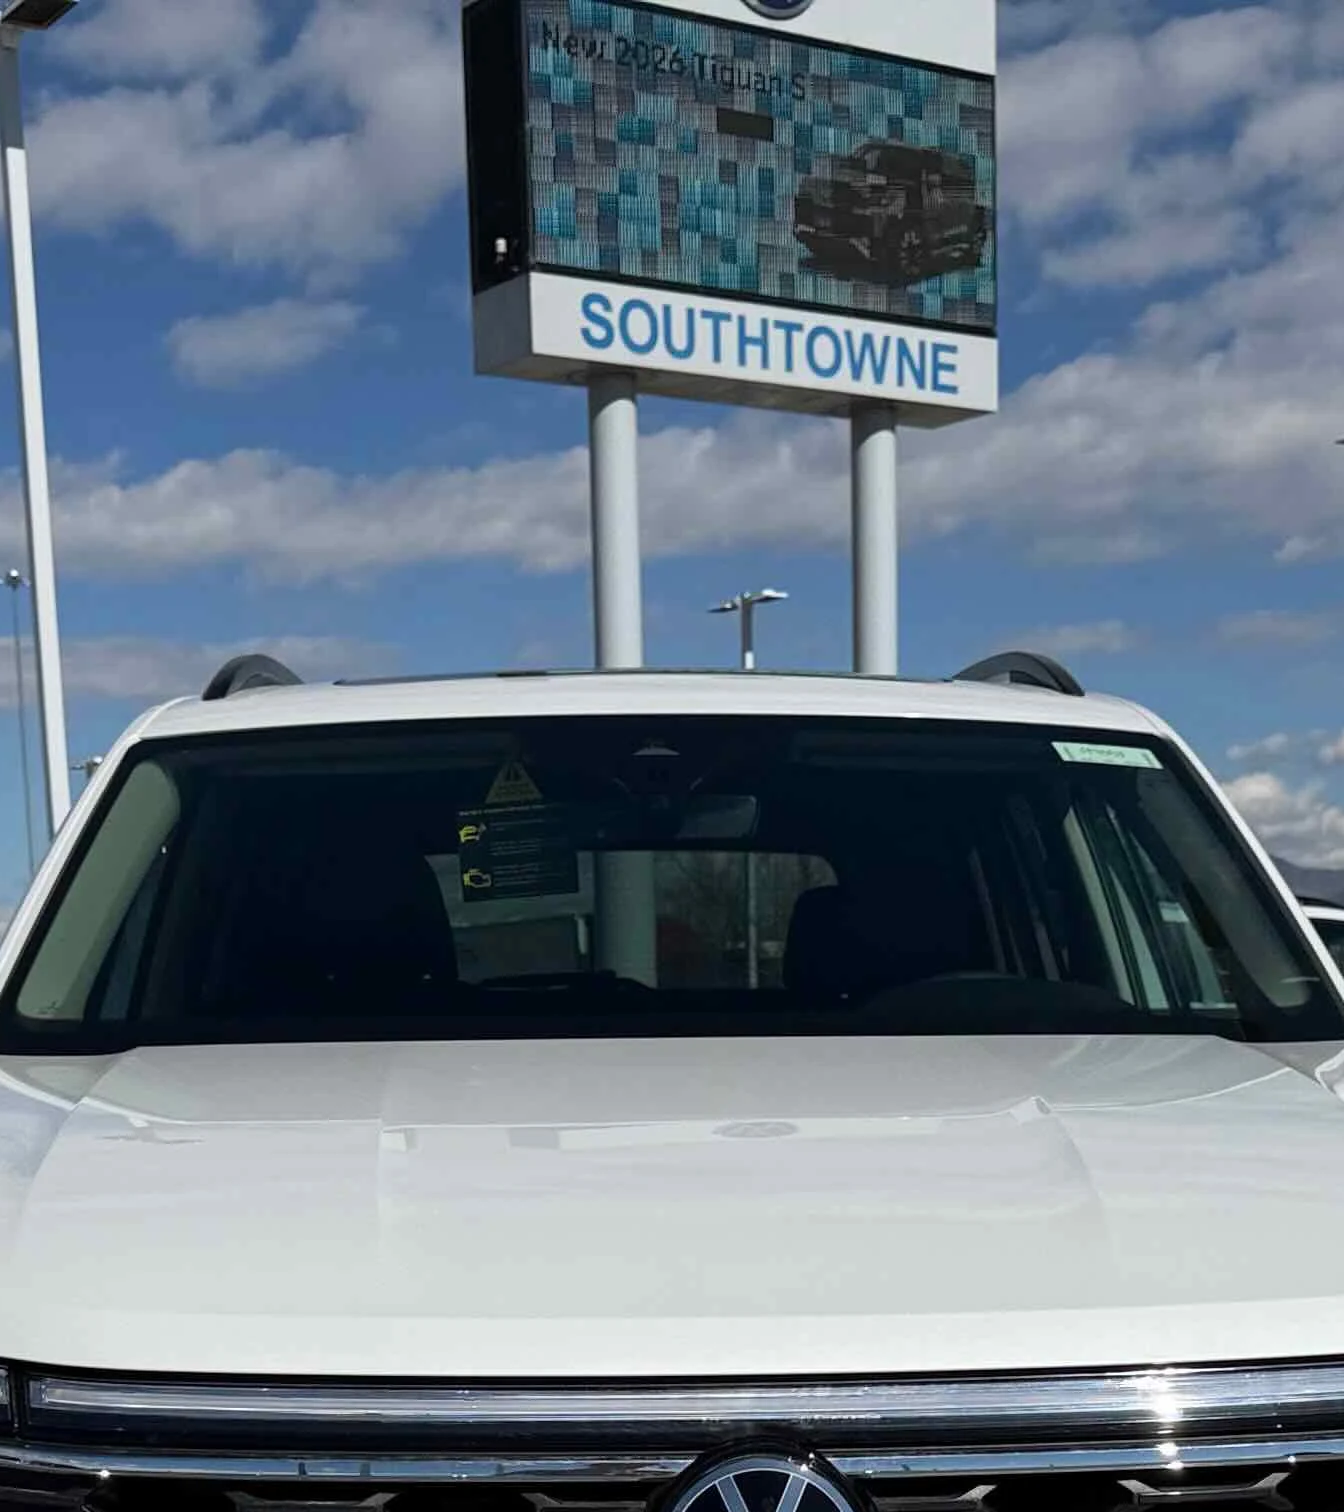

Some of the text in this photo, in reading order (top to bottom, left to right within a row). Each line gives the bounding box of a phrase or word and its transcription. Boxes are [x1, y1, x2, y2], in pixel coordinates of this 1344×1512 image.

[542, 19, 809, 100] New 2026 Tiguan S
[580, 292, 959, 395] SOUTHTOWNE
